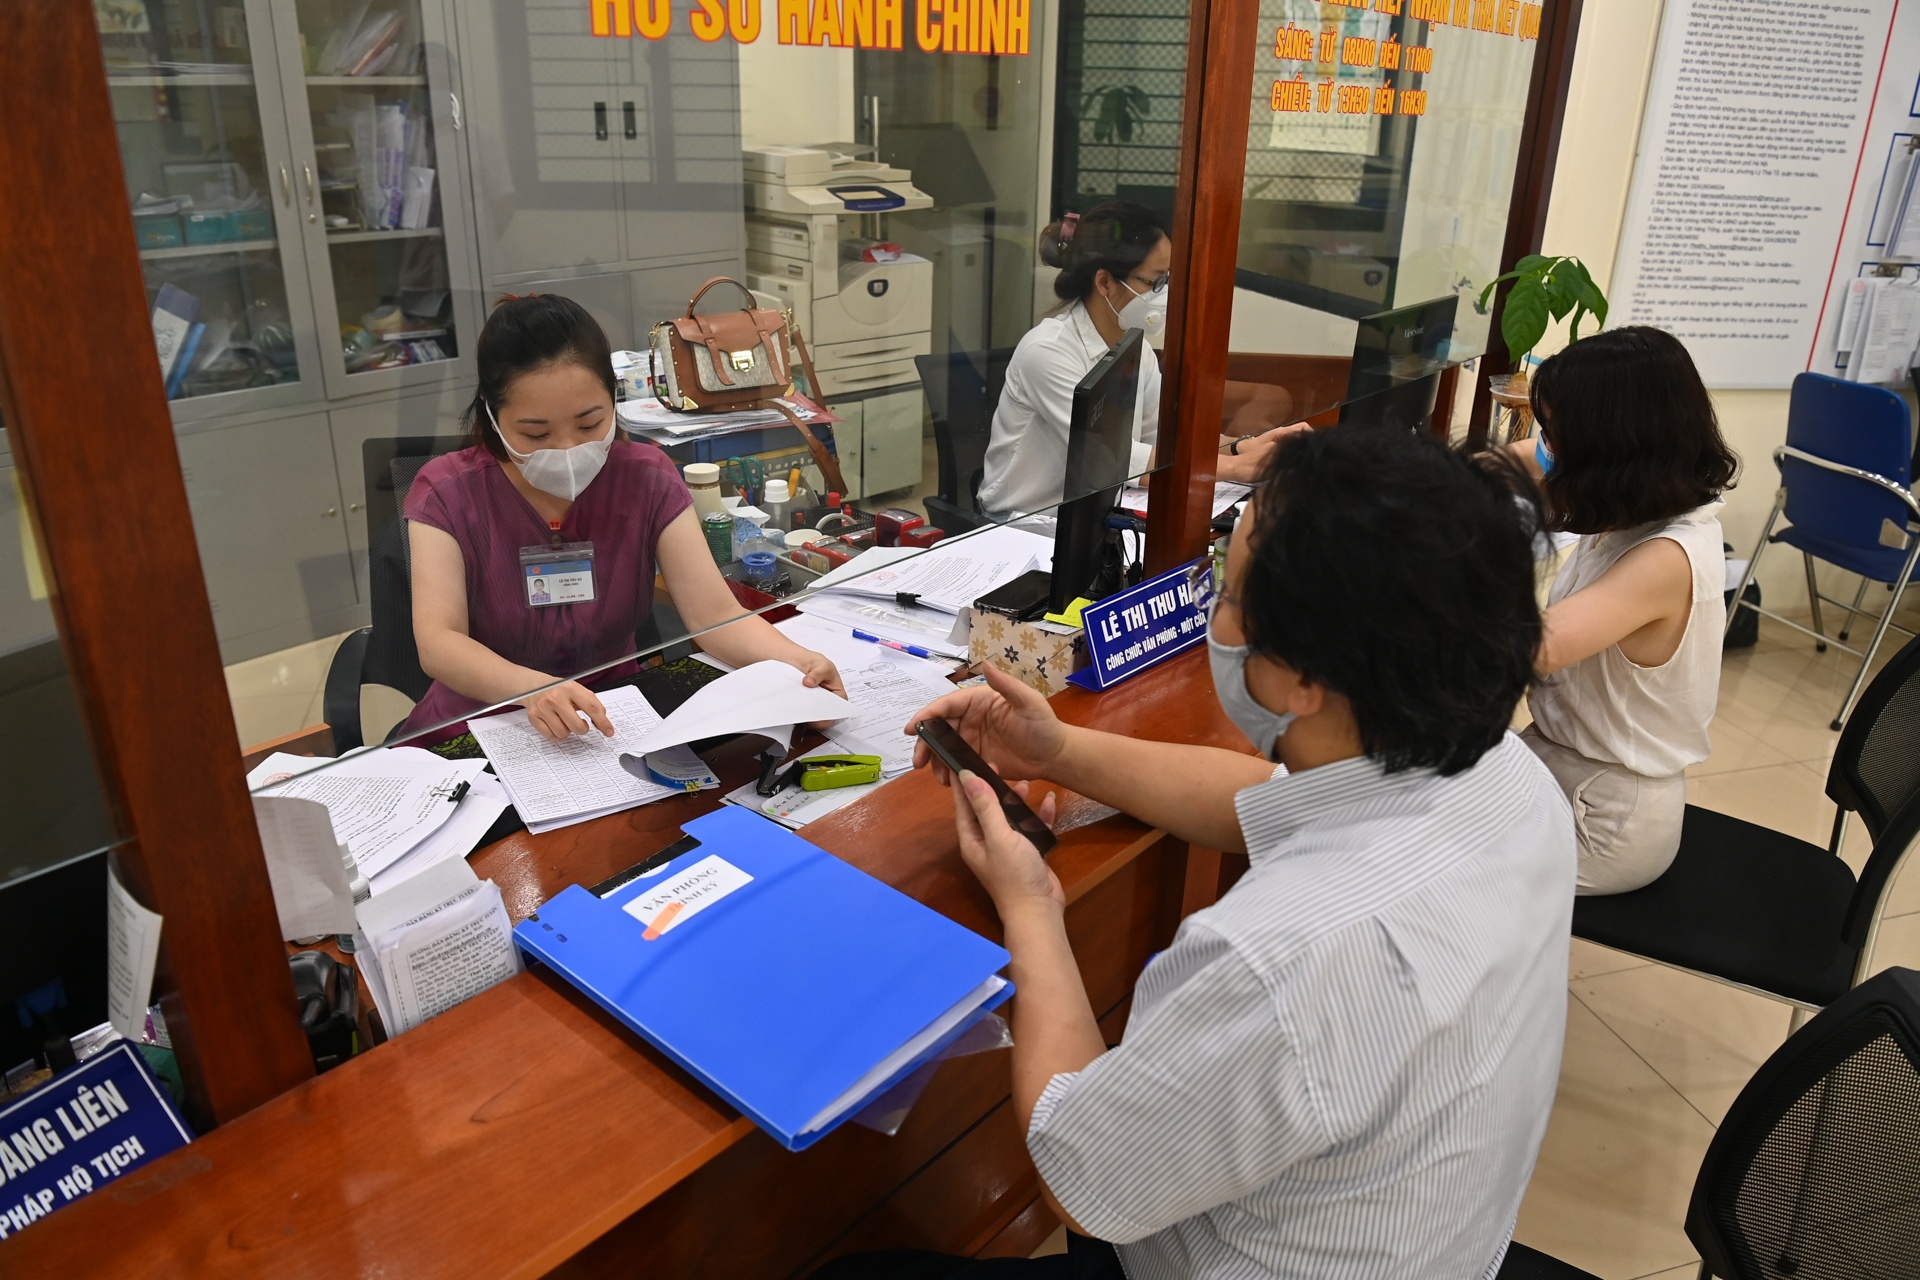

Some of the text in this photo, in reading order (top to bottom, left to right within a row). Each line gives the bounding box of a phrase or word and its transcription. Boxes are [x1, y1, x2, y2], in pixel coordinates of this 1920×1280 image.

[1275, 22, 1432, 73] SÁNG: TỪ 08H00 ĐẾN 11H00
[1271, 71, 1427, 116] CHIỀU: TỪ 13H30 ĐẾN 16H30
[1101, 611, 1122, 643] LÊ
[1121, 603, 1149, 632] THỊ
[1148, 589, 1177, 620] THU
[1105, 653, 1125, 671] CÔNG
[1125, 642, 1143, 662] CHỨC
[1142, 635, 1157, 653] VĂN
[1155, 626, 1178, 647] PHÒNG
[1180, 616, 1193, 635] MỘT
[643, 867, 718, 912] VĂN PHÒNG
[702, 879, 718, 893] KÝ
[54, 1078, 130, 1142] LIÊN
[56, 1164, 94, 1201] HỘ
[90, 1135, 146, 1178] TỊCH
